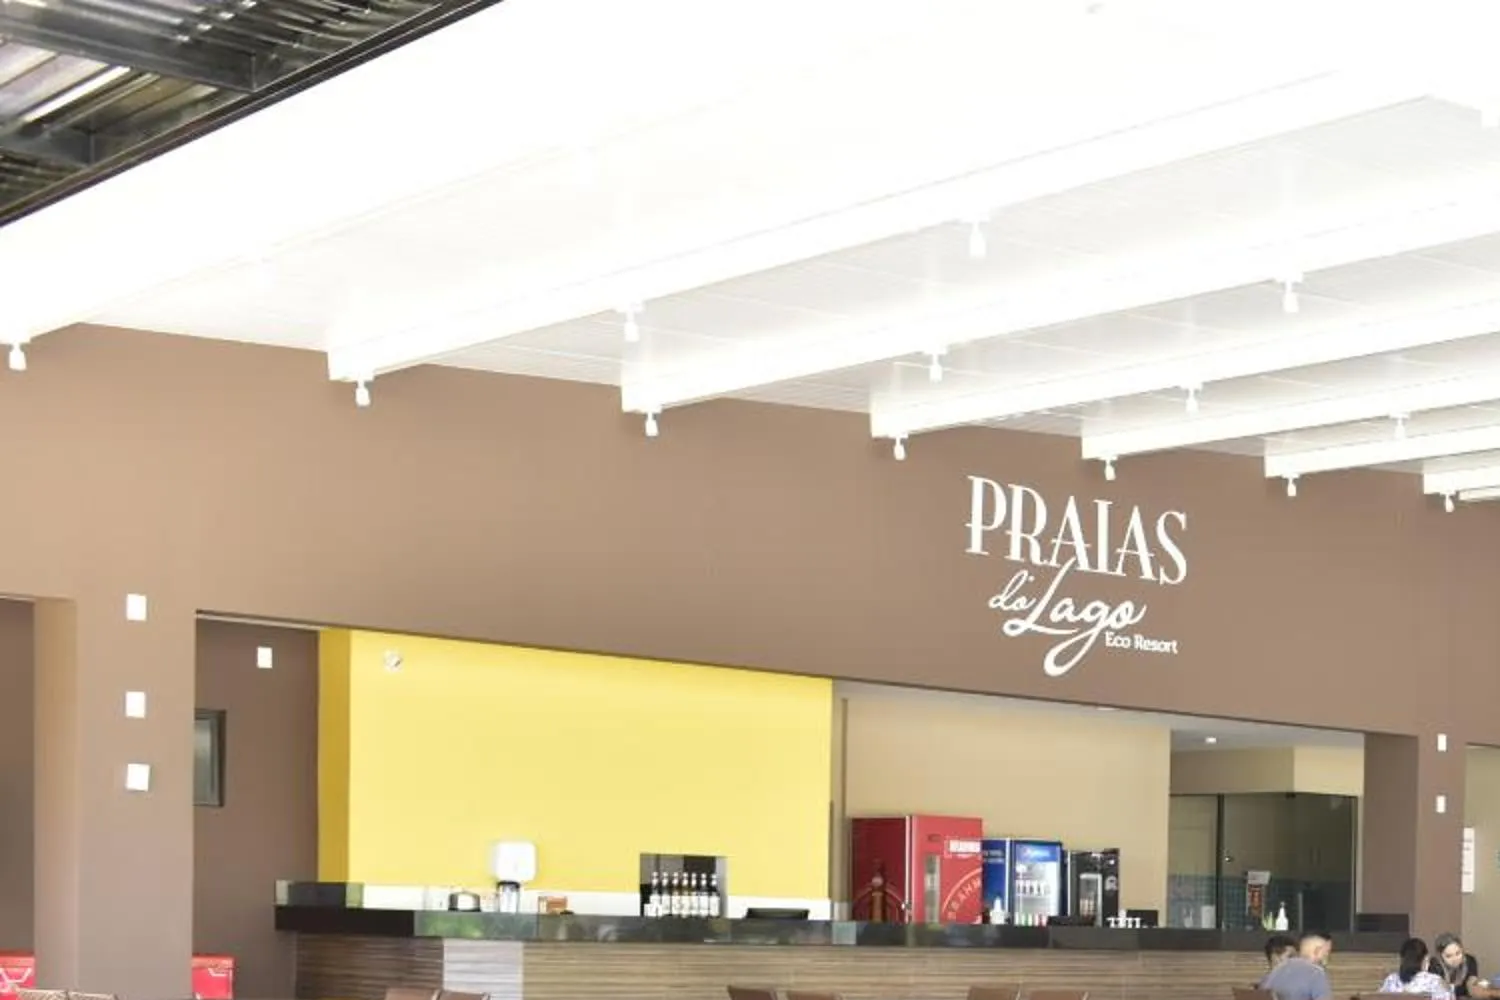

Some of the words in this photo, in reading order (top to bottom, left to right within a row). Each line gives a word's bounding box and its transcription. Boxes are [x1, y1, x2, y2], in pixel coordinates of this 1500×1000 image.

[965, 475, 1187, 585] PRAIAS
[1003, 556, 1147, 676] Lago
[1105, 631, 1131, 649] Eco
[1134, 633, 1178, 654] Resort
